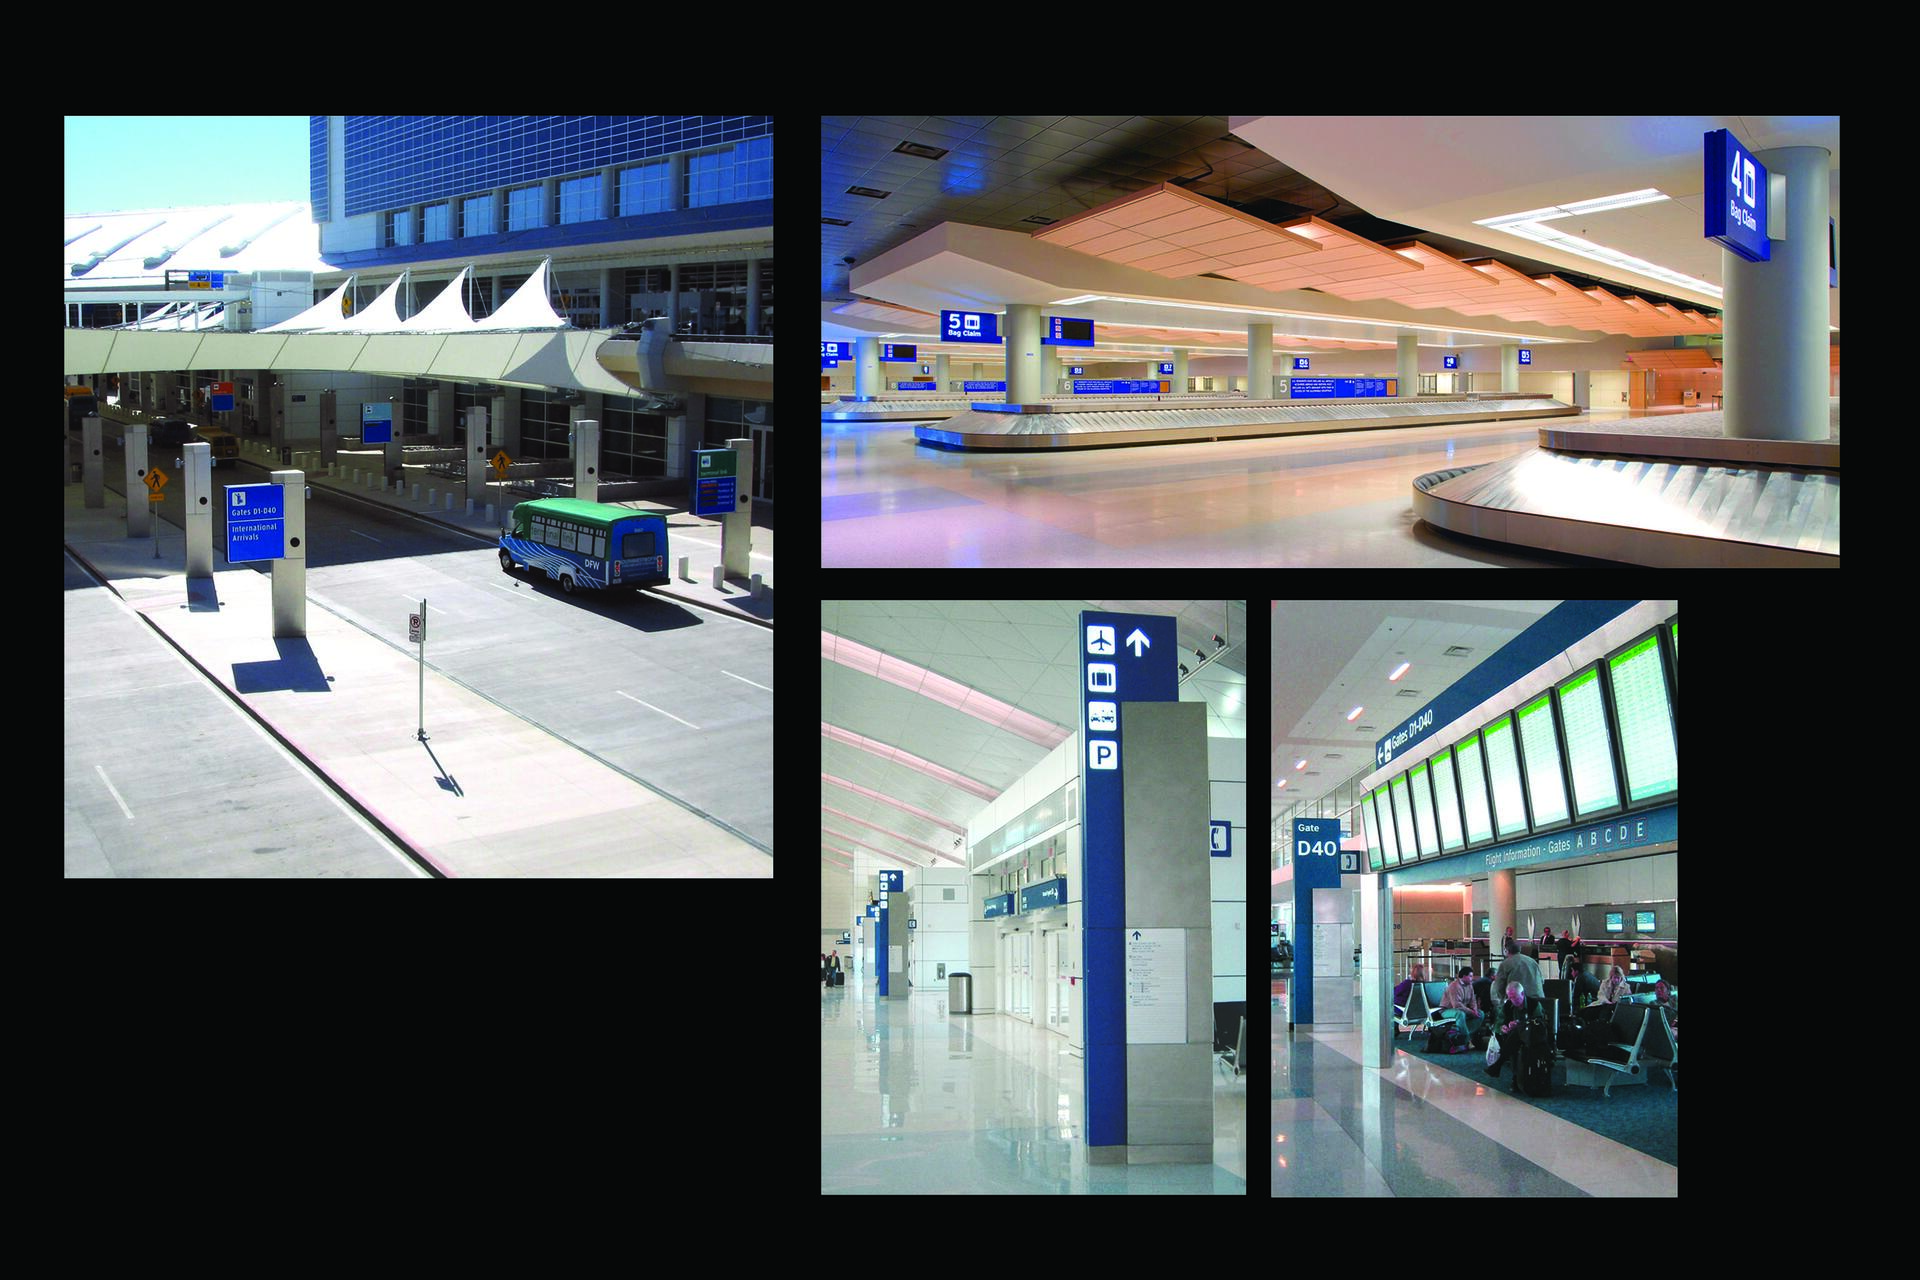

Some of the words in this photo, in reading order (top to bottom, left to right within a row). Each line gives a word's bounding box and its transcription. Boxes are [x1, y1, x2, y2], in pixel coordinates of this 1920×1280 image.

[1731, 150, 1742, 197] 4
[1730, 200, 1741, 226] Bag
[1742, 208, 1756, 232] Claim
[949, 314, 961, 328] 5
[948, 329, 961, 338] Bag
[1064, 380, 1071, 390] 6
[1280, 380, 1287, 393] 5
[253, 507, 277, 515] D1-D40
[232, 523, 277, 533] International
[232, 533, 259, 542] Arrivals
[585, 559, 600, 570] DFW
[1392, 730, 1408, 749] Gates
[1409, 709, 1433, 738] D1-D40
[1097, 745, 1111, 765] P
[1298, 824, 1320, 832] Gate
[1298, 840, 1337, 856] D40
[1486, 854, 1502, 867] Flight
[1503, 846, 1541, 862] Information
[1548, 840, 1570, 854] Gates
[1577, 835, 1583, 848] A
[1591, 832, 1597, 846] B
[1605, 829, 1612, 842] C
[1620, 826, 1627, 840] D
[1637, 822, 1643, 837] E
